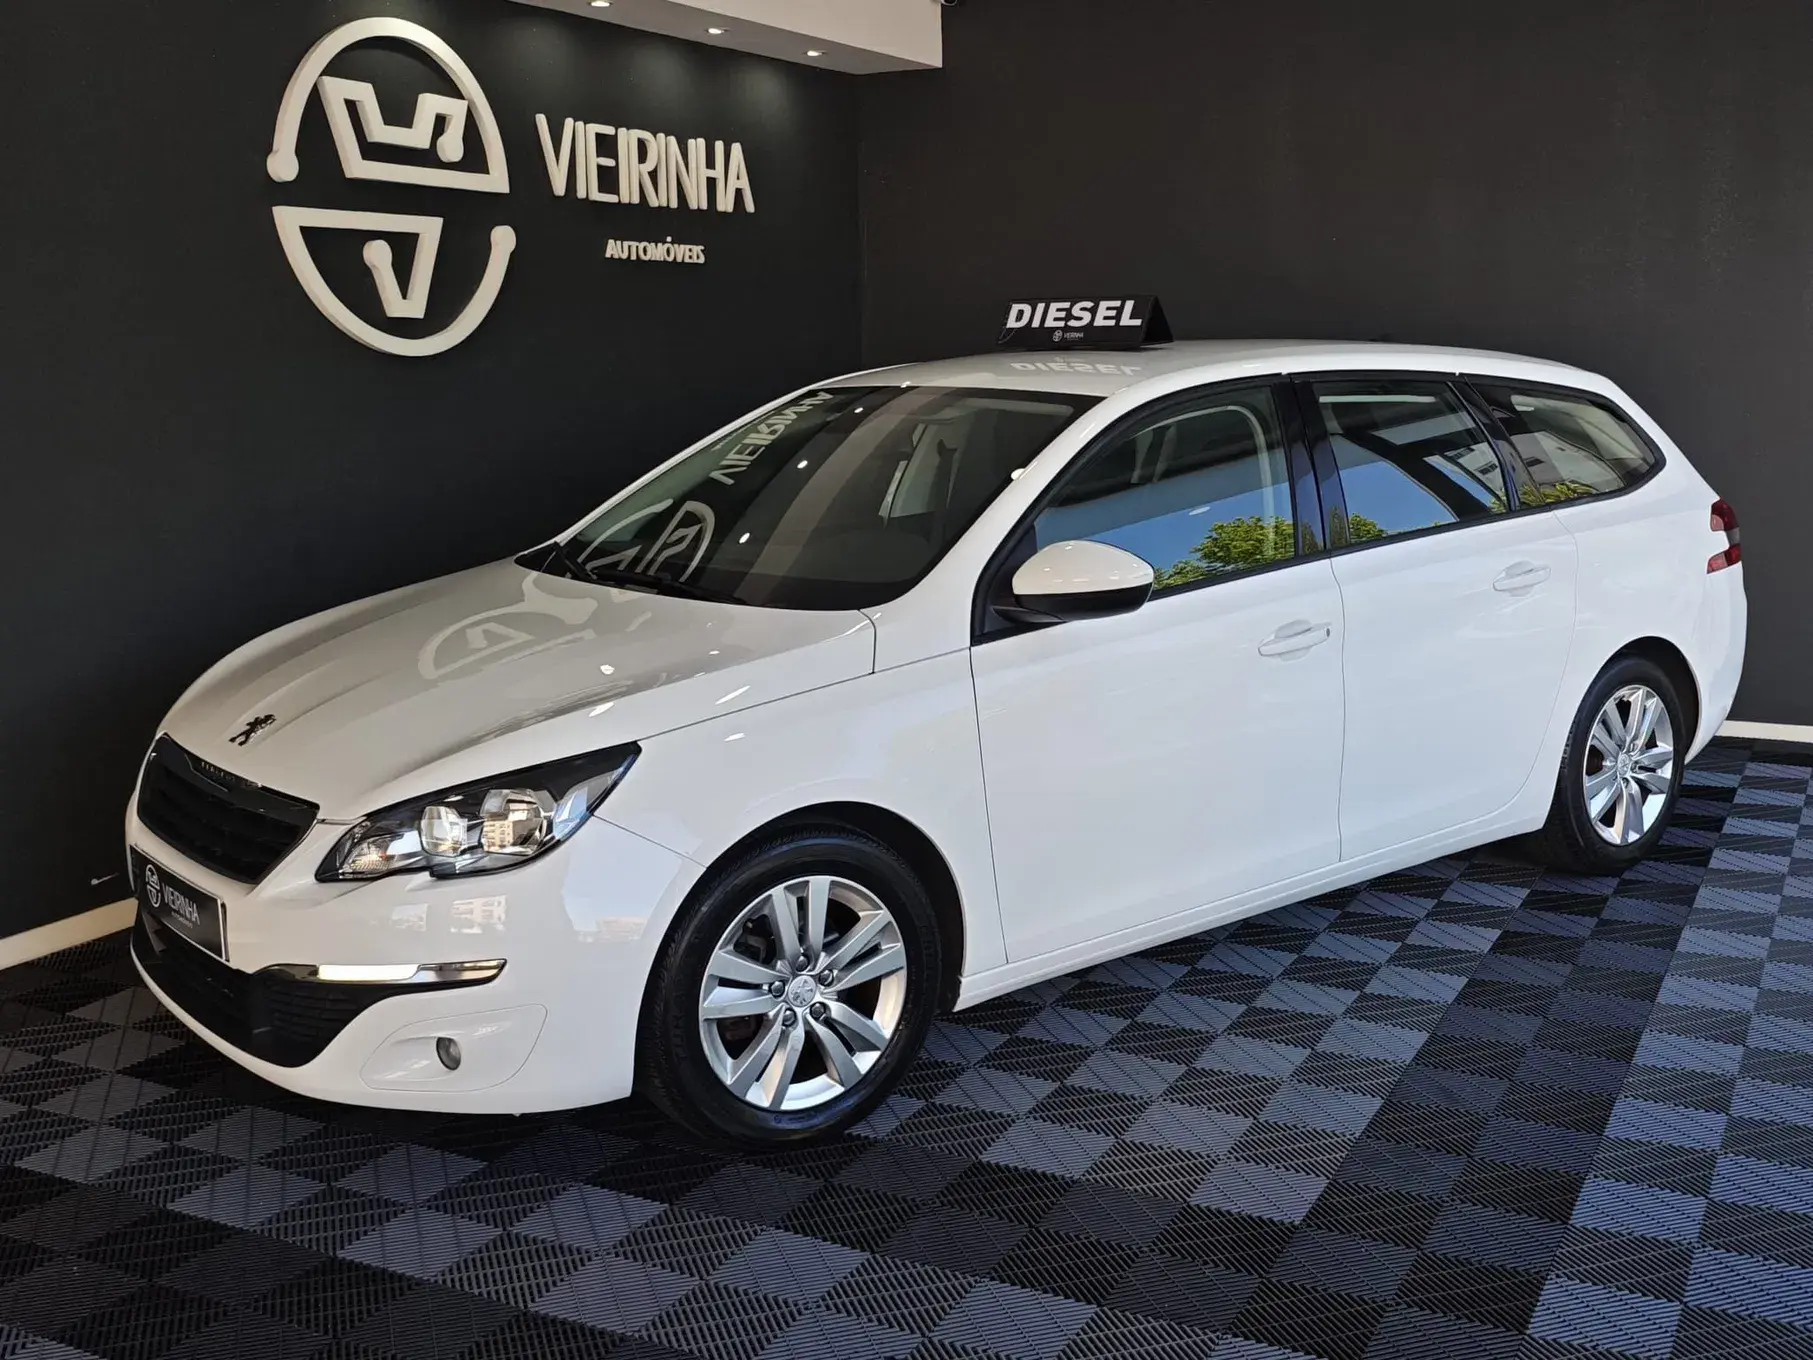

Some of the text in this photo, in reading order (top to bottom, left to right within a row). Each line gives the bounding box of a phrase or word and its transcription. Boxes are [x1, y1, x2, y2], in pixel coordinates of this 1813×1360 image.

[535, 113, 755, 213] VIEIRINHA
[605, 236, 705, 264] AUTOMÓVEIS
[1006, 300, 1143, 328] DIESEL
